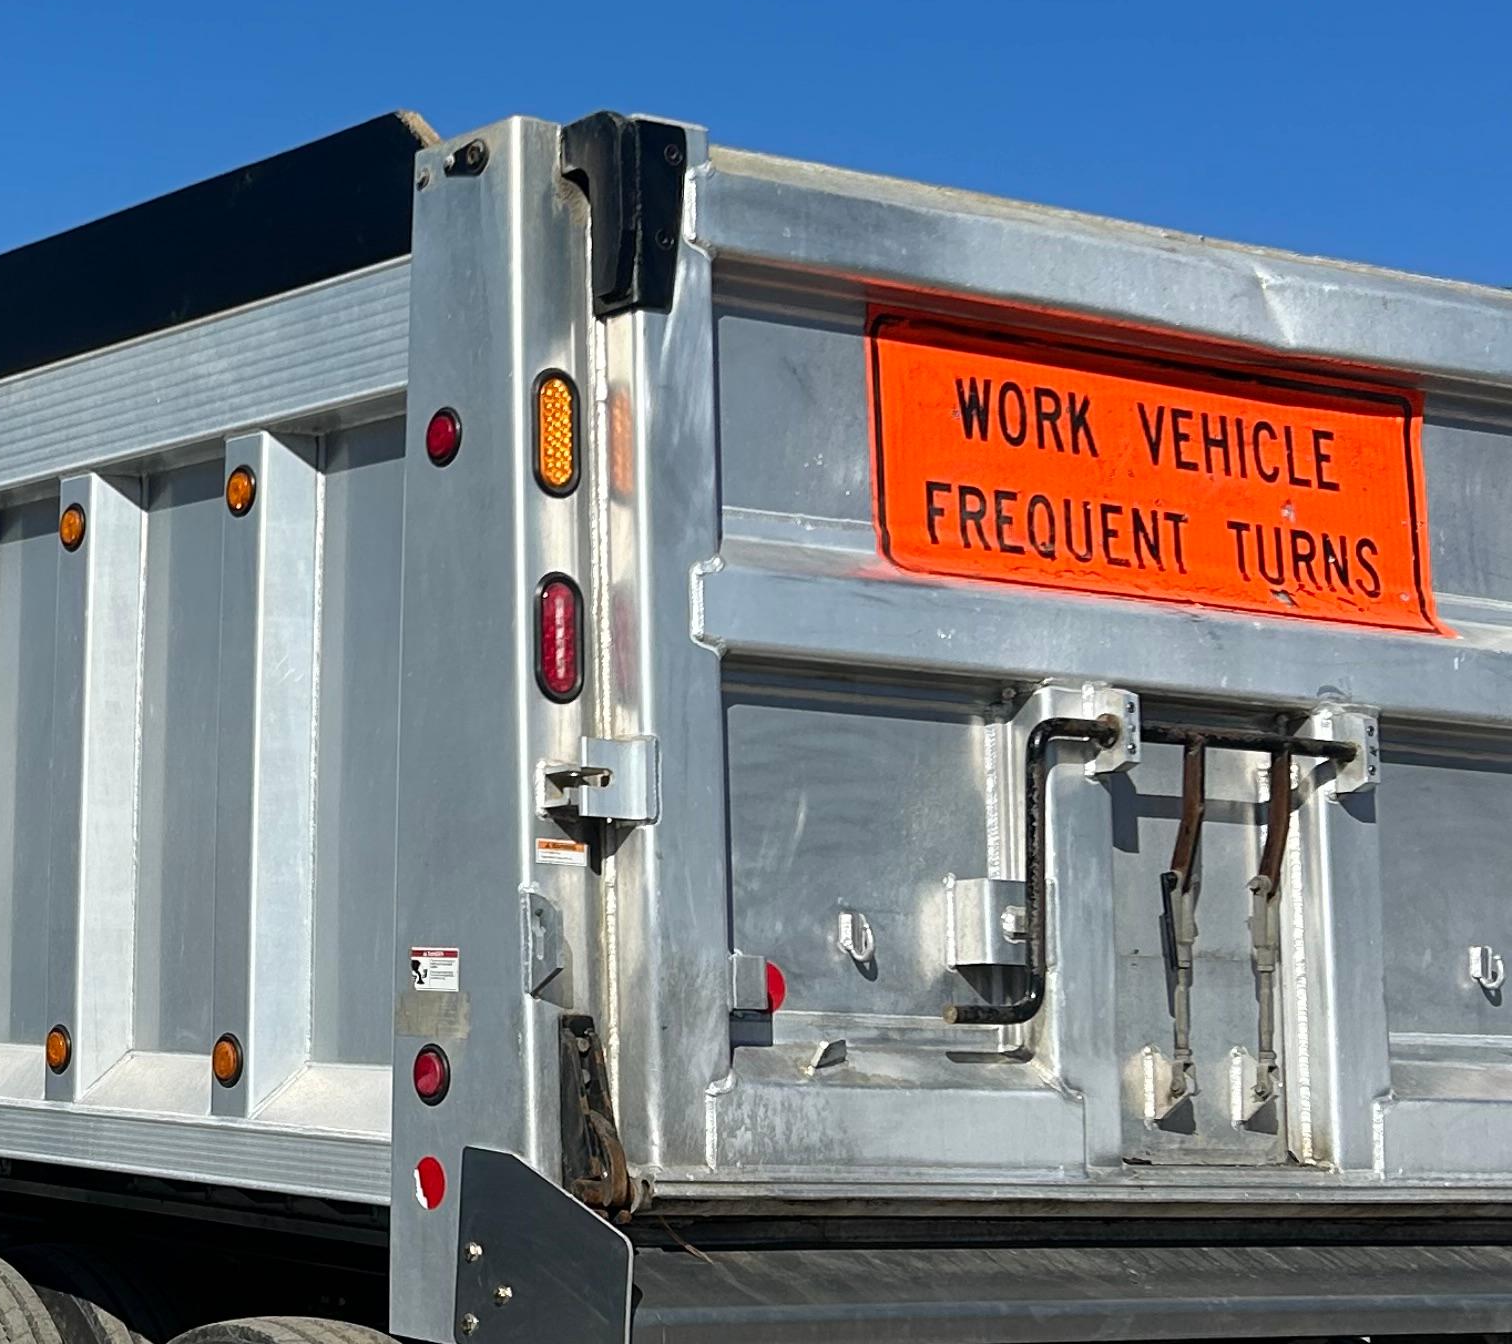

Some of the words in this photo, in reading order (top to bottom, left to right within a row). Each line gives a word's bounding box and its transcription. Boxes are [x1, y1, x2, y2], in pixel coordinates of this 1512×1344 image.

[955, 376, 1099, 458] WORK
[1136, 401, 1340, 492] VEHICLE
[925, 480, 1188, 575] FREQUENT
[1227, 520, 1382, 599] TURNS
